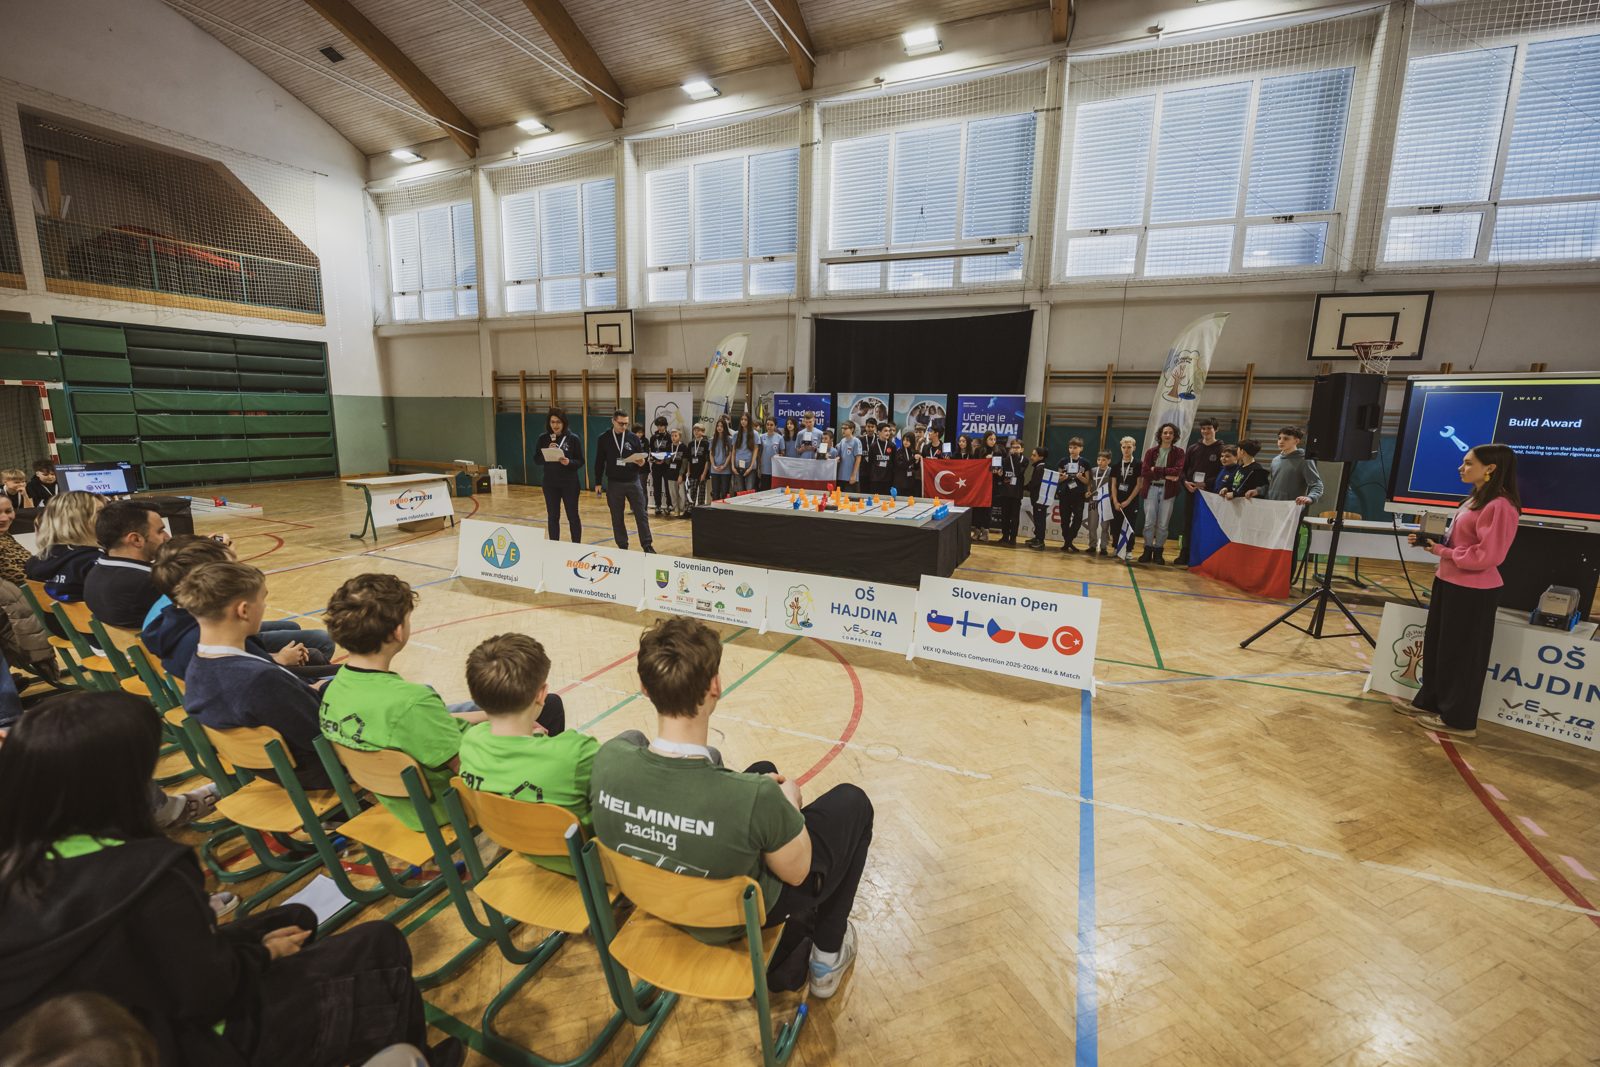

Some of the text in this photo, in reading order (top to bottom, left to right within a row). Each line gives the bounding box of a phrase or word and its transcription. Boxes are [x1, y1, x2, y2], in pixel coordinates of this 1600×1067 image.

[778, 409, 825, 418] Prihodost
[962, 412, 1006, 423] Učenje je
[961, 422, 1018, 435] ZABAVA!
[1508, 418, 1583, 428] Build Award
[414, 494, 433, 502] TECH
[566, 559, 622, 575] ROBO TECH
[673, 560, 734, 576] Slovenian Open
[480, 570, 519, 582] www.mdeptuj.si
[568, 587, 617, 600] www.robotech.si
[855, 586, 875, 602] OŠ
[951, 586, 1058, 612] Slovenian Open
[830, 602, 898, 625] HAJDINA
[843, 624, 882, 638] VEX IQ
[841, 635, 882, 646] COMPETITION
[942, 648, 967, 658] Robotics
[968, 654, 1005, 666] Competition
[1005, 660, 1040, 672] 2025-2026:
[1060, 670, 1081, 680] Match
[1537, 645, 1586, 670] OŠ
[1487, 663, 1600, 703] HAJDIN
[1502, 698, 1596, 730] VEX IQ
[1497, 712, 1592, 742] COMPETITION
[598, 790, 715, 837] HELMINEN
[624, 821, 678, 852] racing
